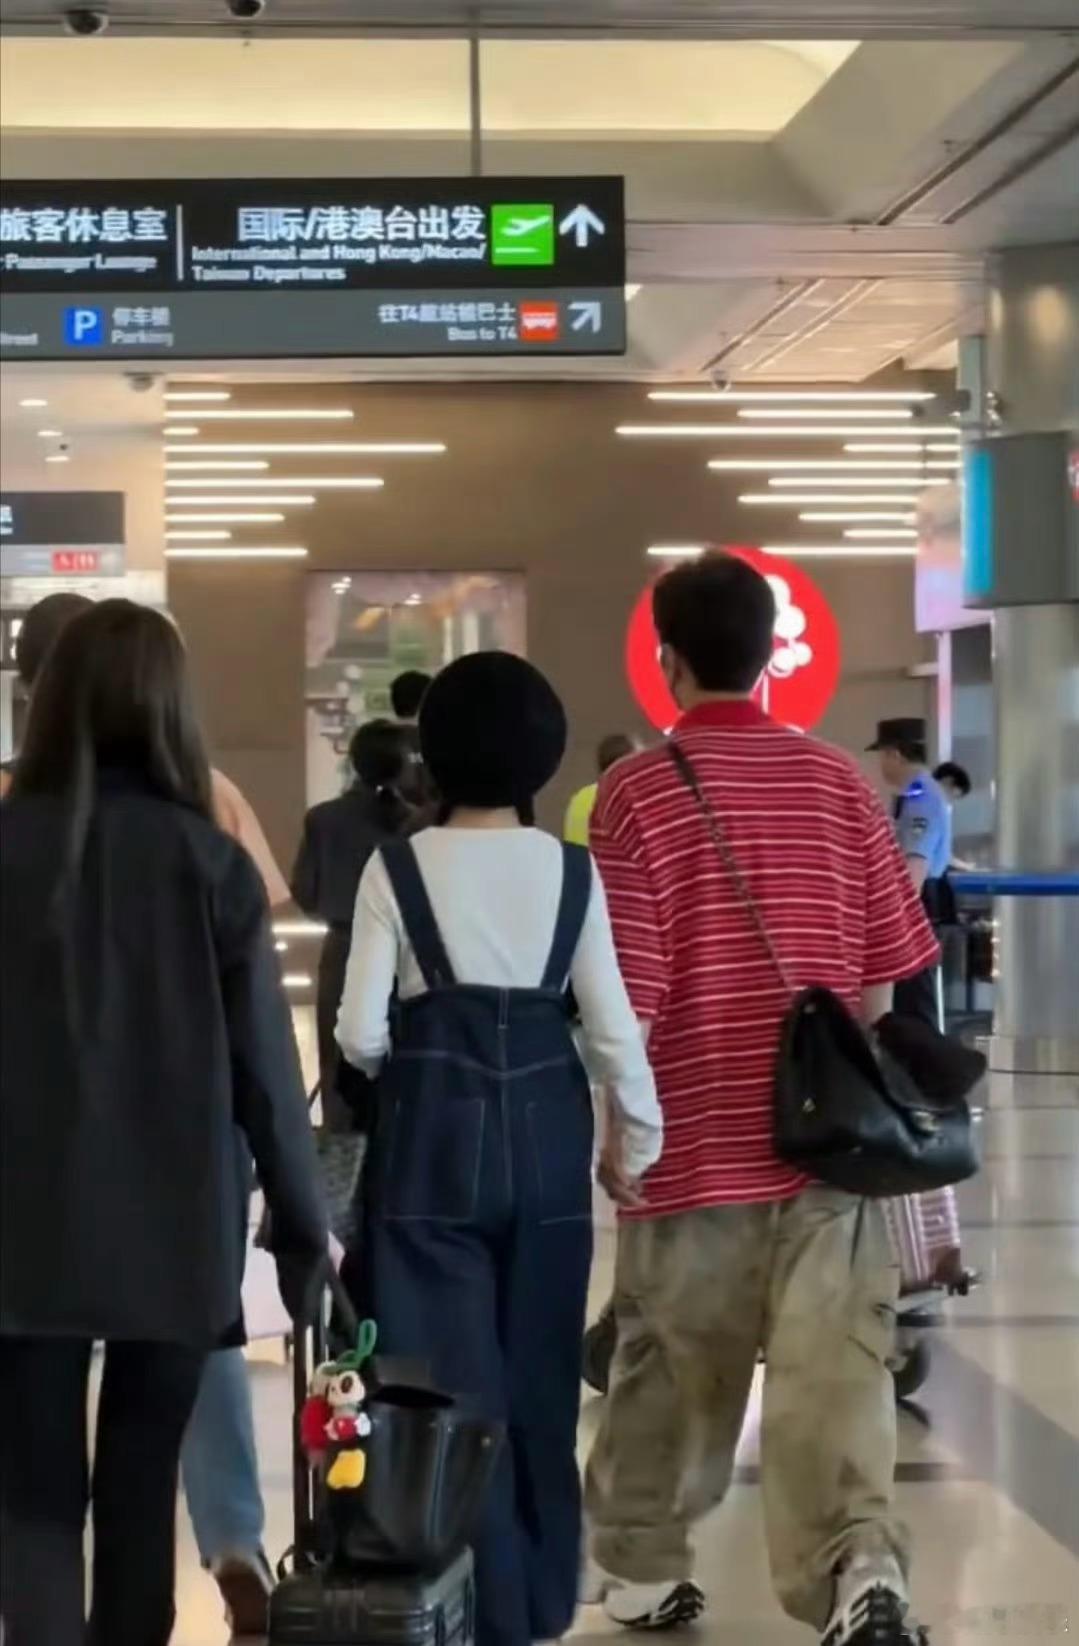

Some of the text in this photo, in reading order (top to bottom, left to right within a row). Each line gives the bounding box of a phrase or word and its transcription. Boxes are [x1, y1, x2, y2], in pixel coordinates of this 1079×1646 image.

[0, 206, 168, 242] 旅客休息室
[237, 205, 486, 242] 国际/港澳台出发
[333, 245, 376, 264] Hong
[74, 310, 98, 340] P
[448, 326, 519, 341] Bus to T4
